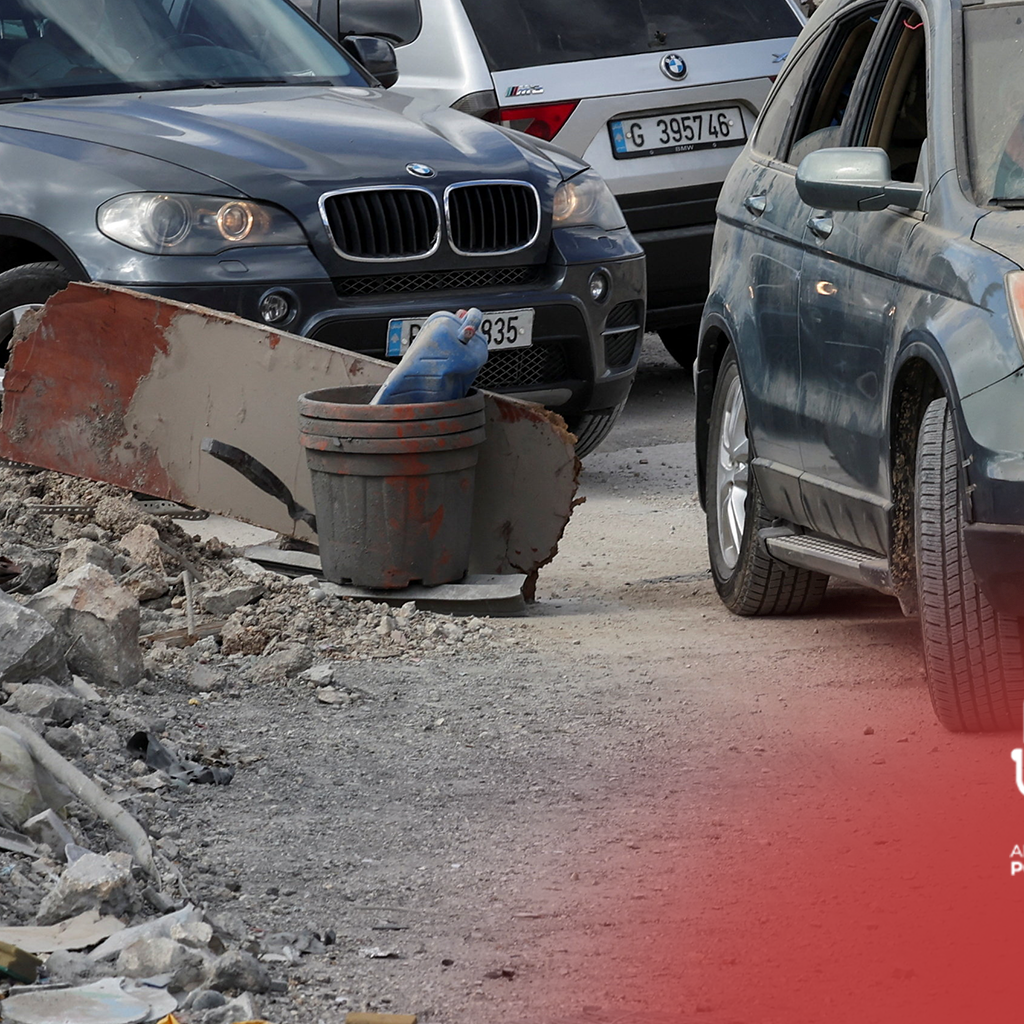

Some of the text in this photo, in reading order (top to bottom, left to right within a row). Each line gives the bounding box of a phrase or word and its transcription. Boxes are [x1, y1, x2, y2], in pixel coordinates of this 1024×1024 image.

[630, 112, 730, 147] G 395746
[675, 144, 694, 152] BMW
